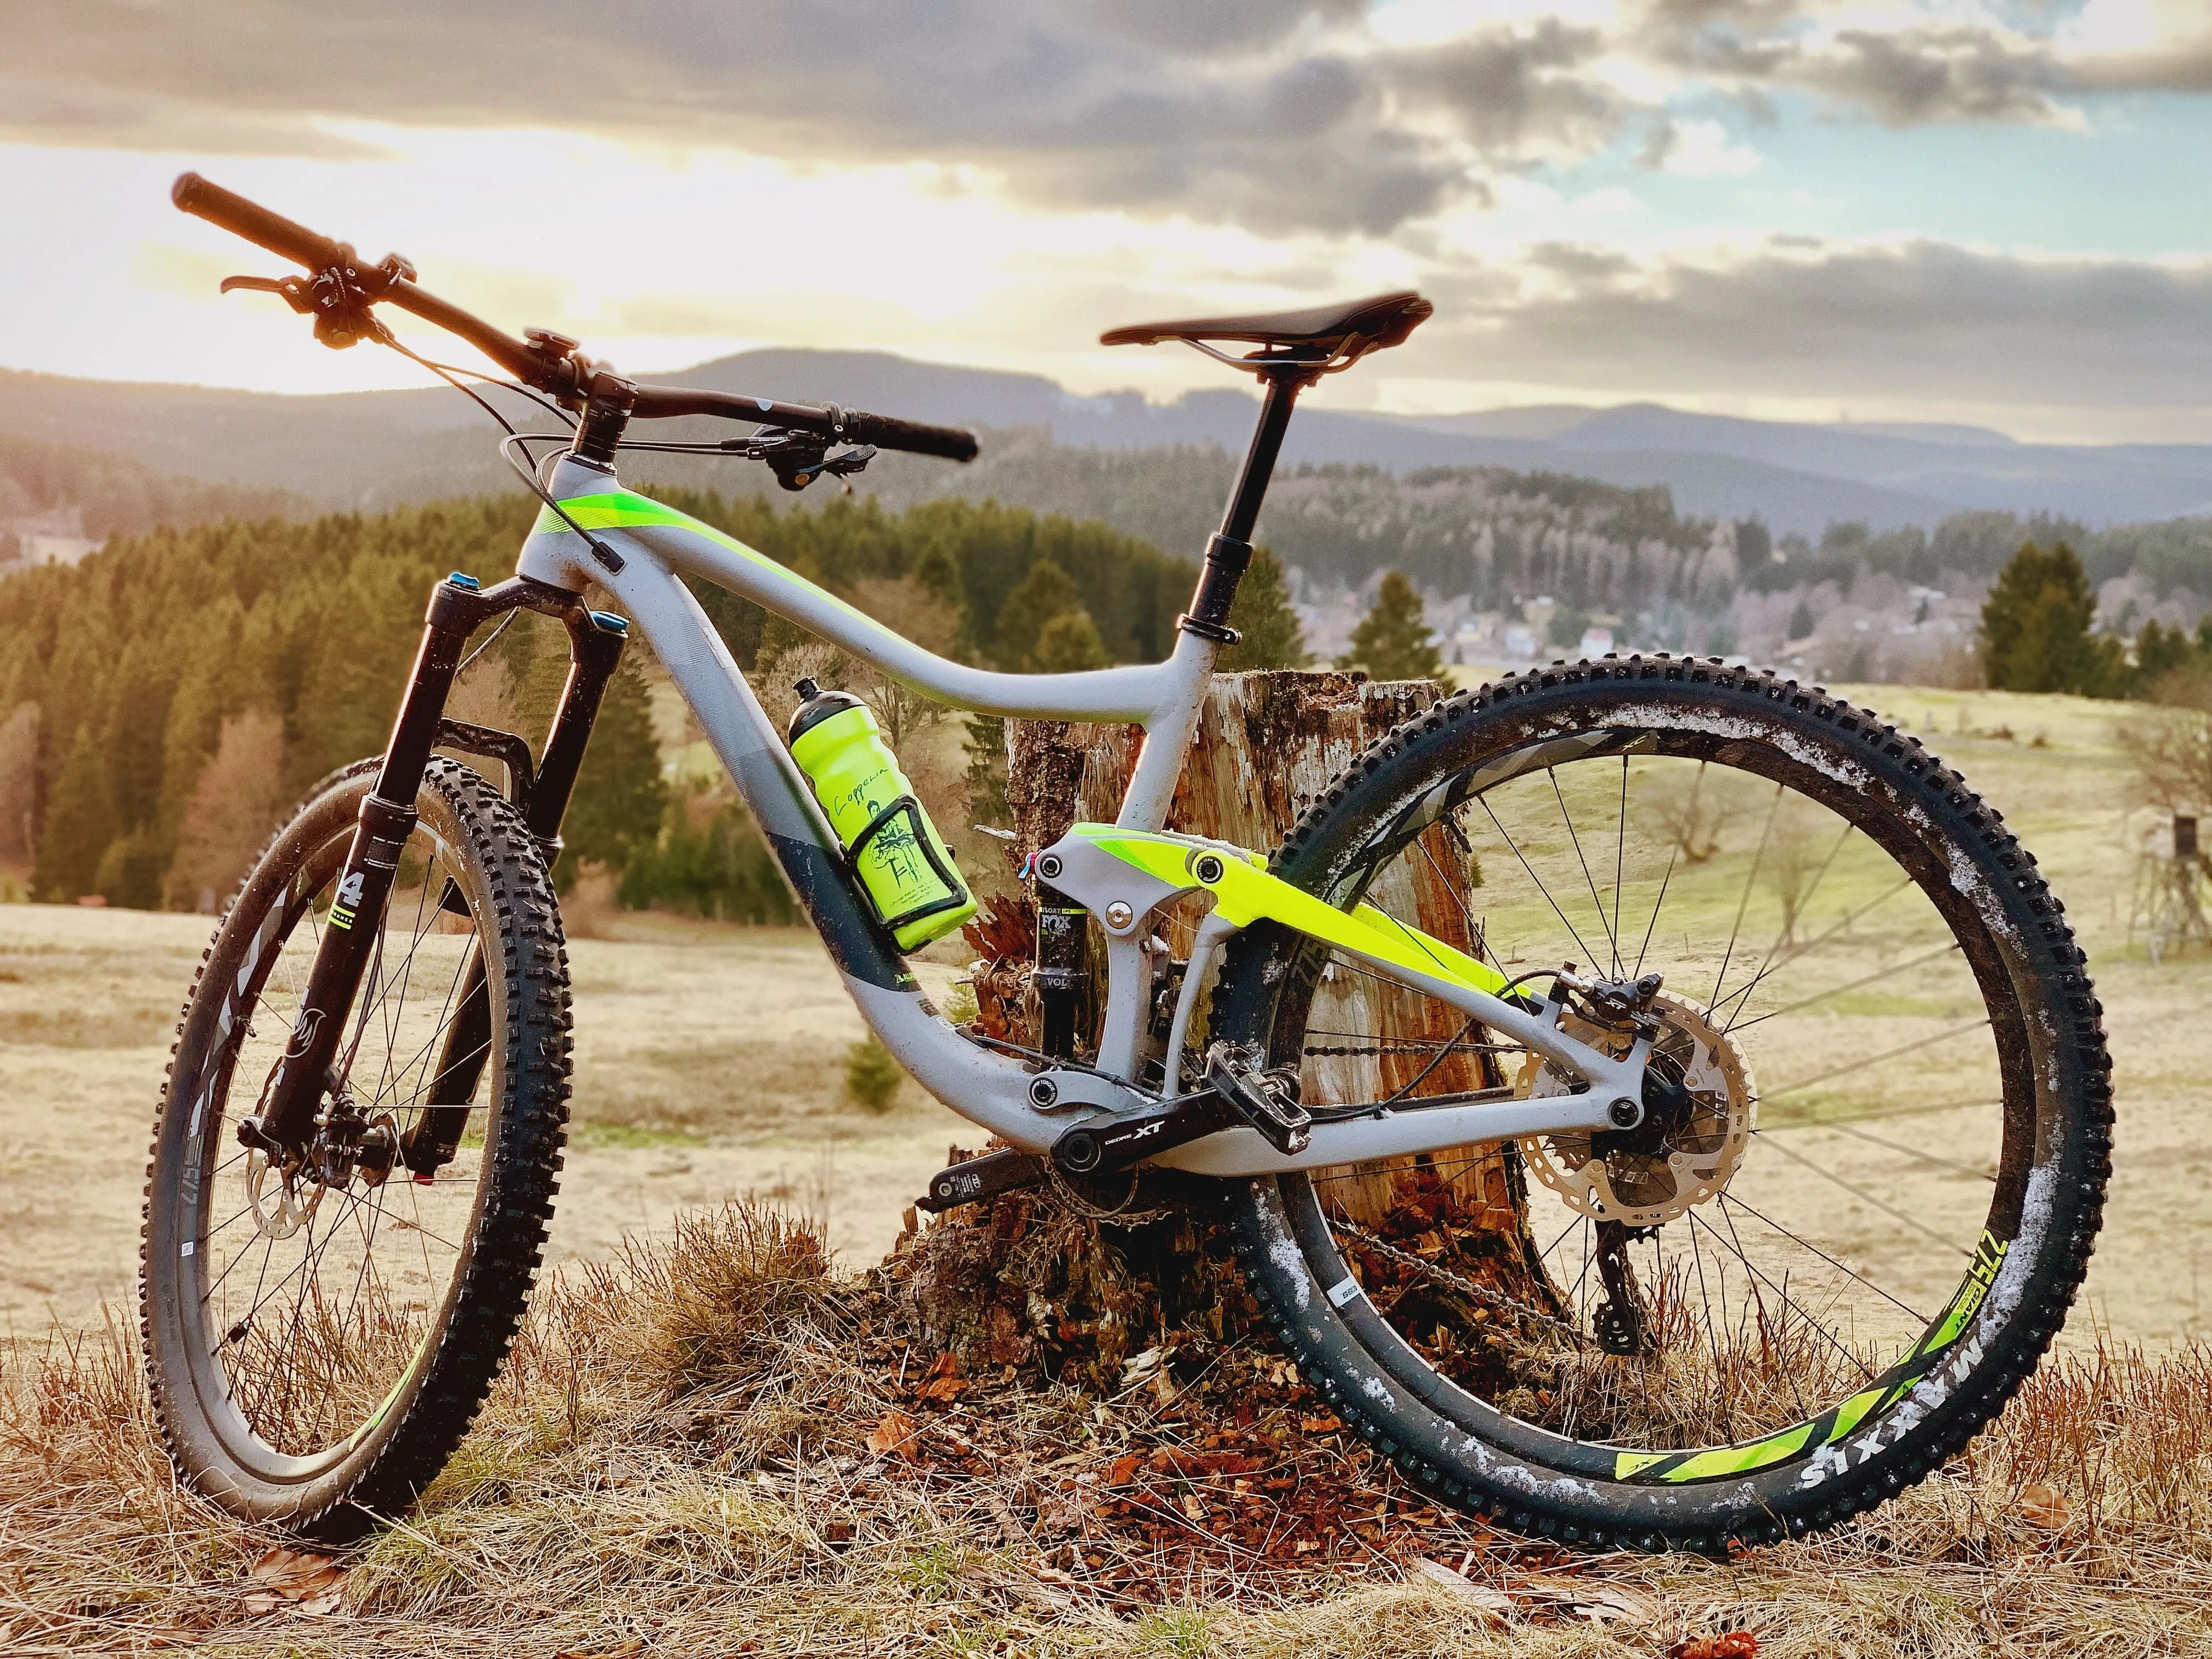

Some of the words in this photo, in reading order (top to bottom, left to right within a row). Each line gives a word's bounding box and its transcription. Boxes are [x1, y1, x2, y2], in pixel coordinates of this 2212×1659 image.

[1042, 915, 1071, 936] FOX
[1105, 1134, 1132, 1146] DEORE
[1133, 1120, 1165, 1139] XT
[1968, 1228, 2008, 1285] 27.5
[1955, 1287, 1980, 1332] GIANT
[1801, 1335, 1984, 1489] MAXXIS
